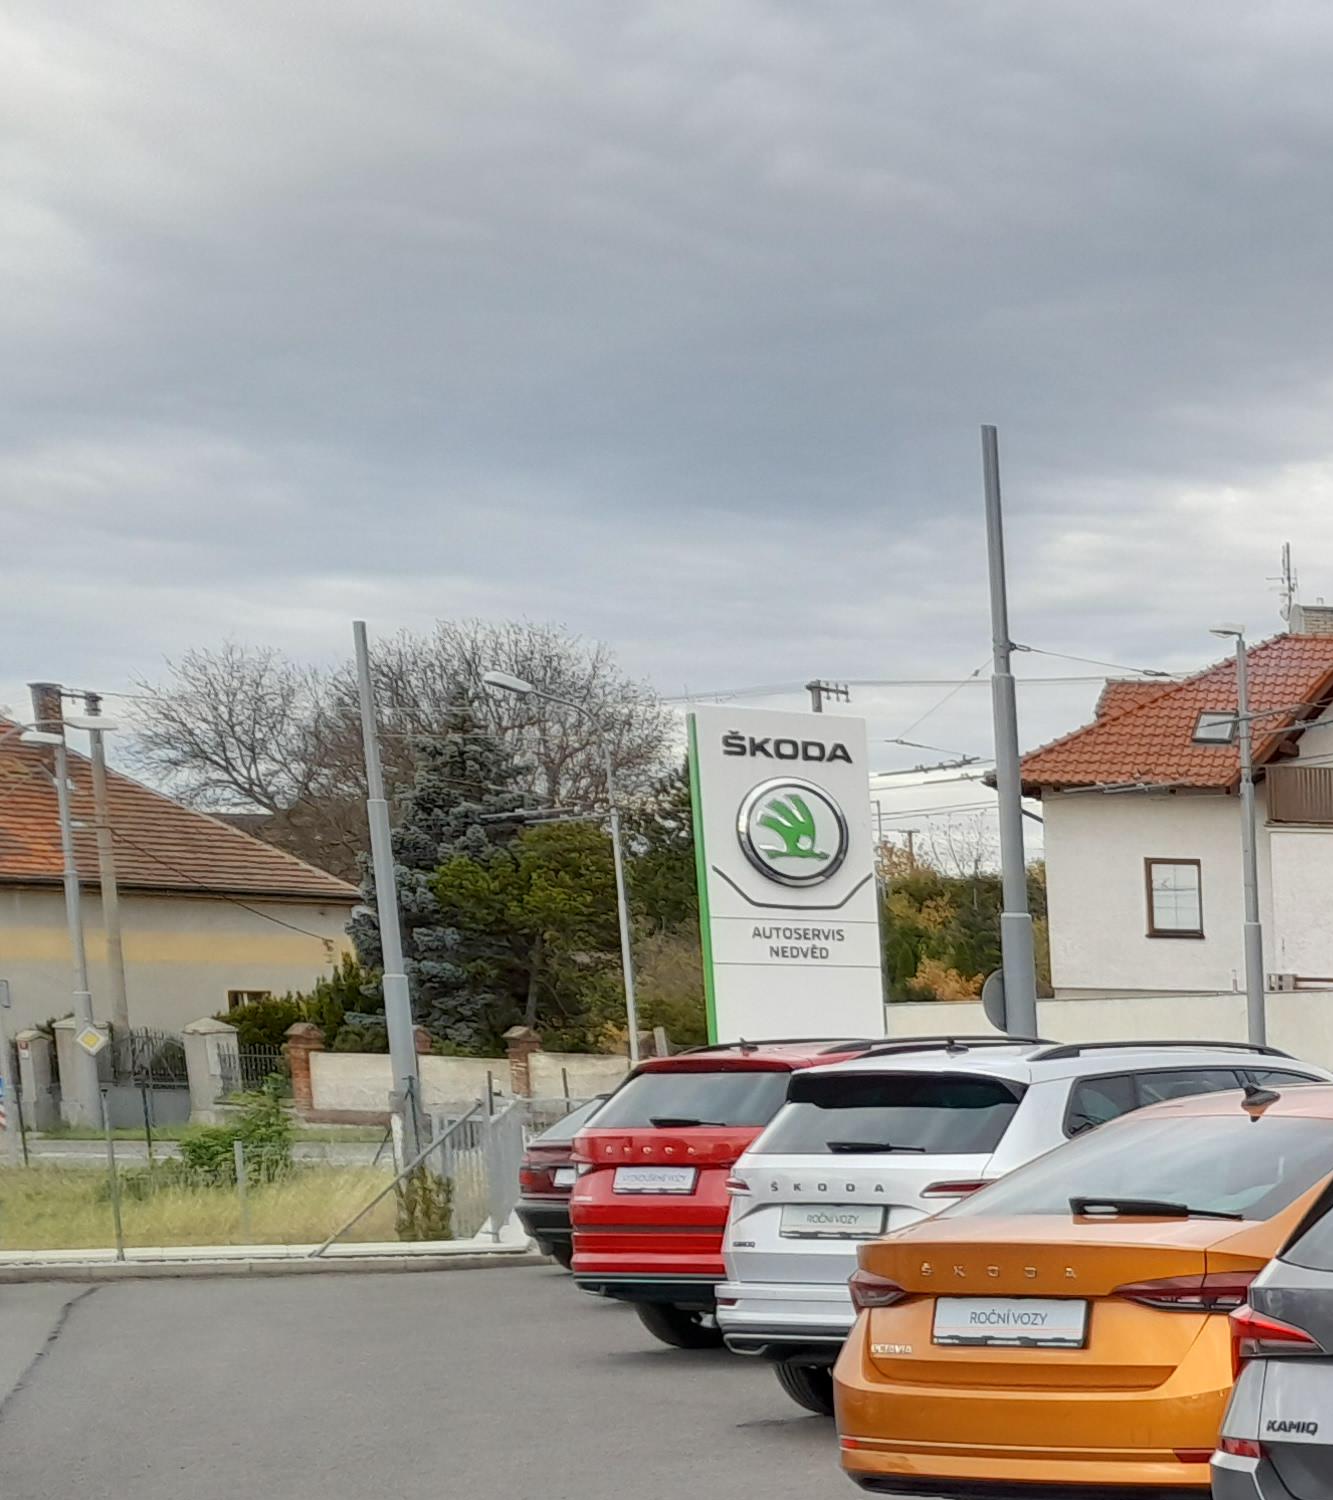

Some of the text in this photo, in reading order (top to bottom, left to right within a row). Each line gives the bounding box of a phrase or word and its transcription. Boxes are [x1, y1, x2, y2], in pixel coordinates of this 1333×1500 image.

[722, 730, 853, 764] ŠKODA
[752, 926, 845, 942] AUTOSERVIS
[770, 944, 829, 960] NEDVĚD
[770, 1181, 884, 1192] ŠKODA
[835, 1214, 860, 1224] VOZY
[920, 1261, 1077, 1279] ŠKODA
[969, 1309, 1048, 1326] ROČNÍ VOZY
[1266, 1420, 1318, 1436] KAMIQ
